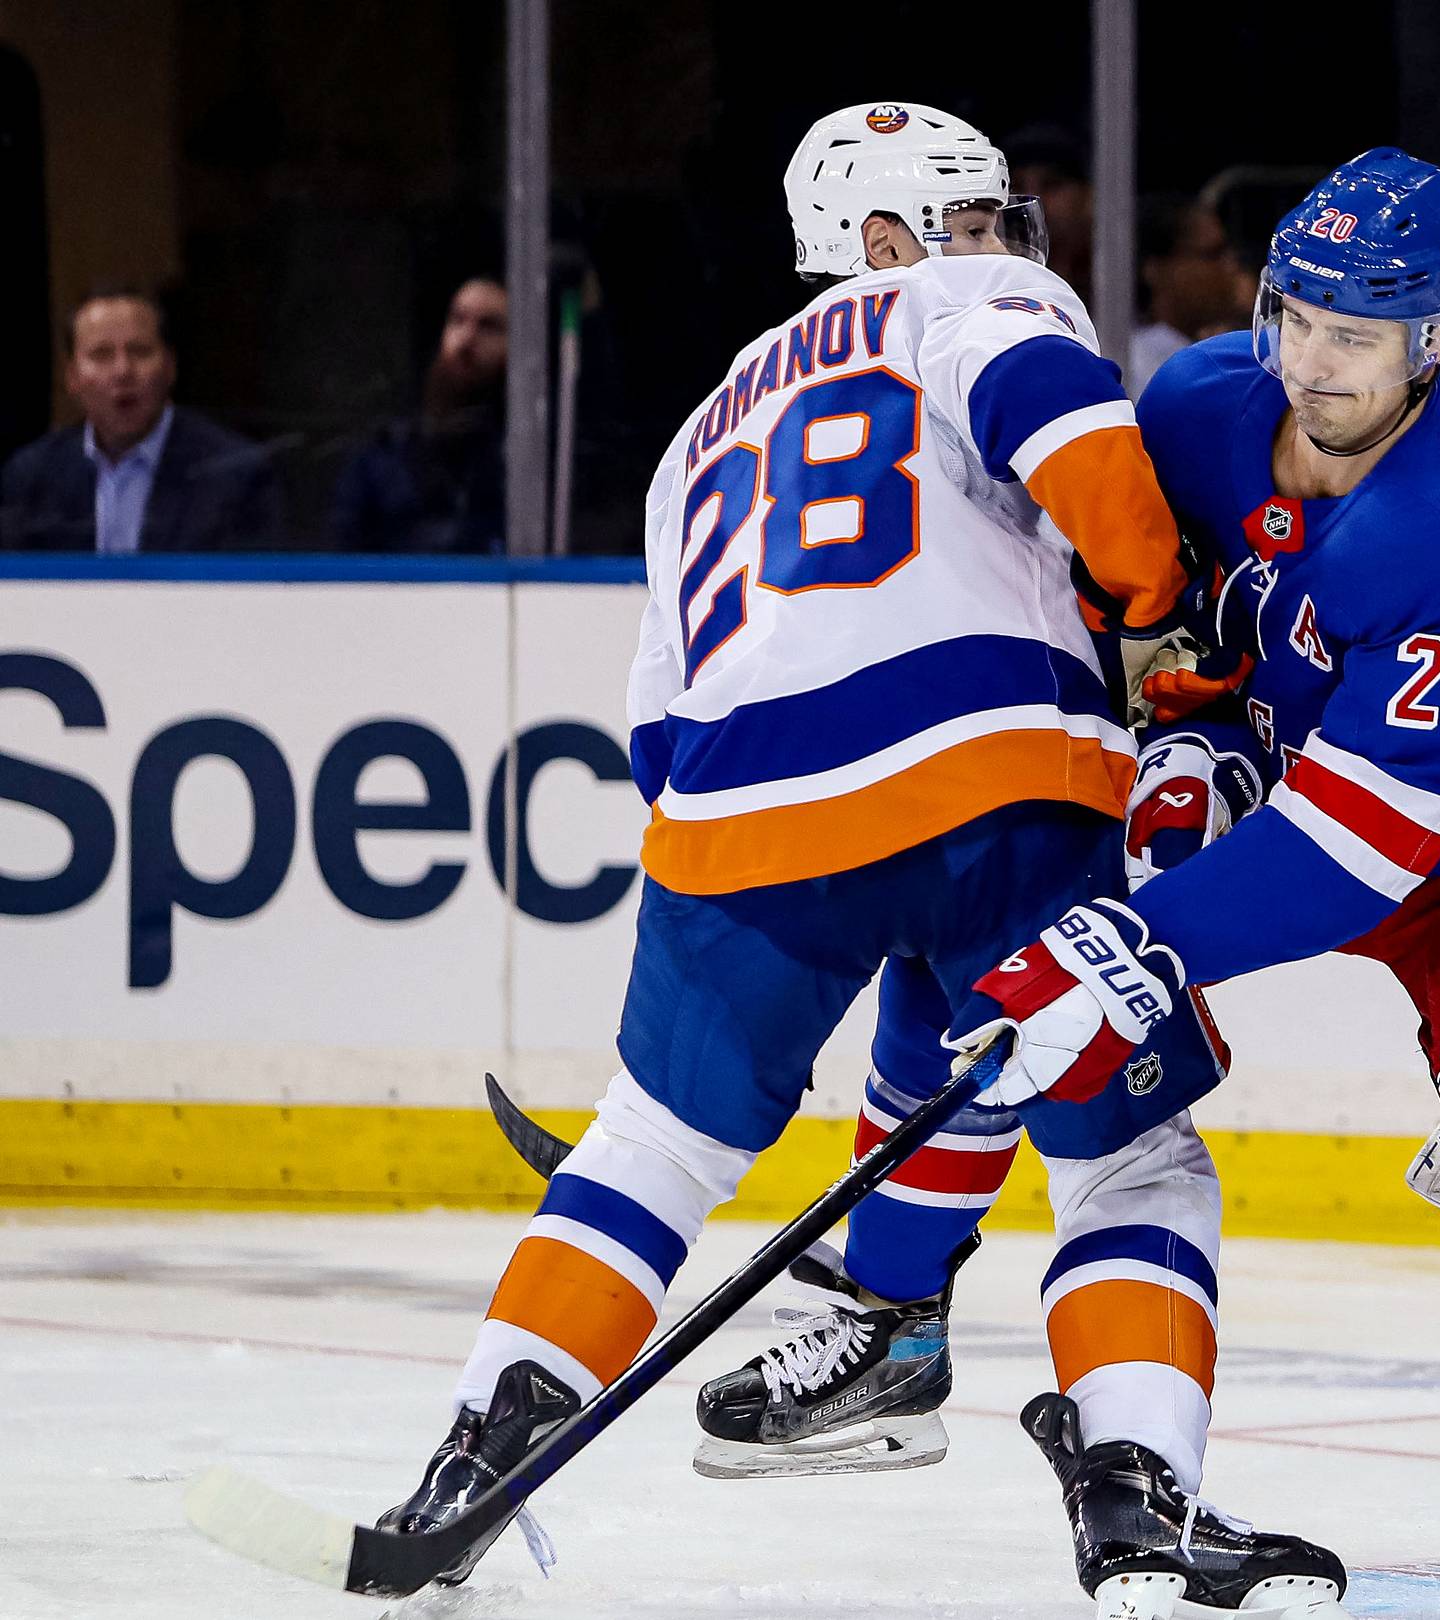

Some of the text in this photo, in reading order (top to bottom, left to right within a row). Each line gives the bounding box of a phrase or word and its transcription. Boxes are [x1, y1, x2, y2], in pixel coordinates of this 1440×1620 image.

[1308, 207, 1358, 244] 20
[684, 289, 900, 486] ROMANOV
[678, 365, 923, 690] 28
[1268, 517, 1287, 531] NHL
[1289, 593, 1333, 671] A
[1135, 1063, 1156, 1090] NHL
